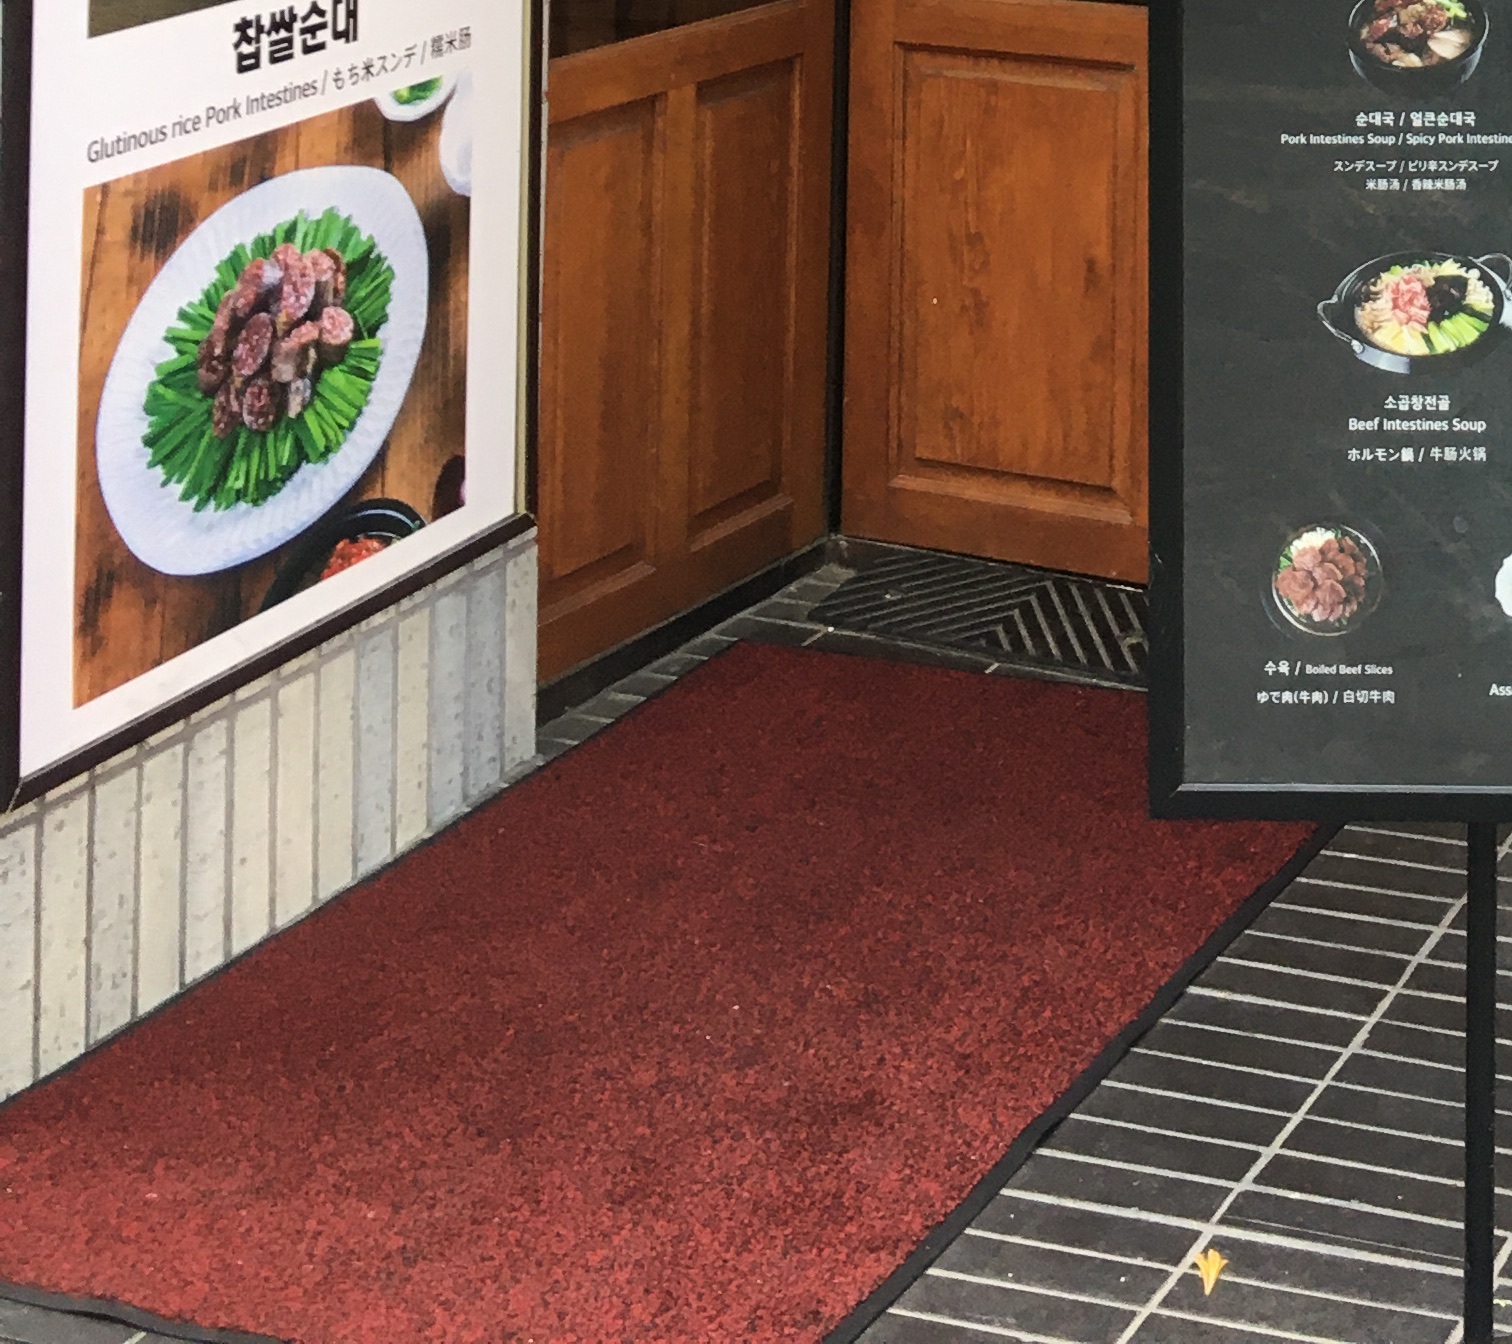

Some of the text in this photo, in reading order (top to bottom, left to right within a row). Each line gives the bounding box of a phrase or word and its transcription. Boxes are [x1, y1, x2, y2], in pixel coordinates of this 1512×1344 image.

[87, 44, 418, 164] Glutinous rice Pork Intestines もち米スンデ
[1355, 111, 1476, 127] 순대국 얼큰순대국
[1281, 133, 1307, 144] Pork
[1309, 133, 1365, 145] Intestines
[1367, 133, 1396, 146] Soup
[1406, 133, 1436, 146] Spicy
[1438, 133, 1464, 144] Pork
[1384, 394, 1450, 411] 소곱창전골
[1348, 417, 1487, 433] Beef Intestines Soup
[1264, 660, 1393, 676] 수육 Boiled Beef Slices
